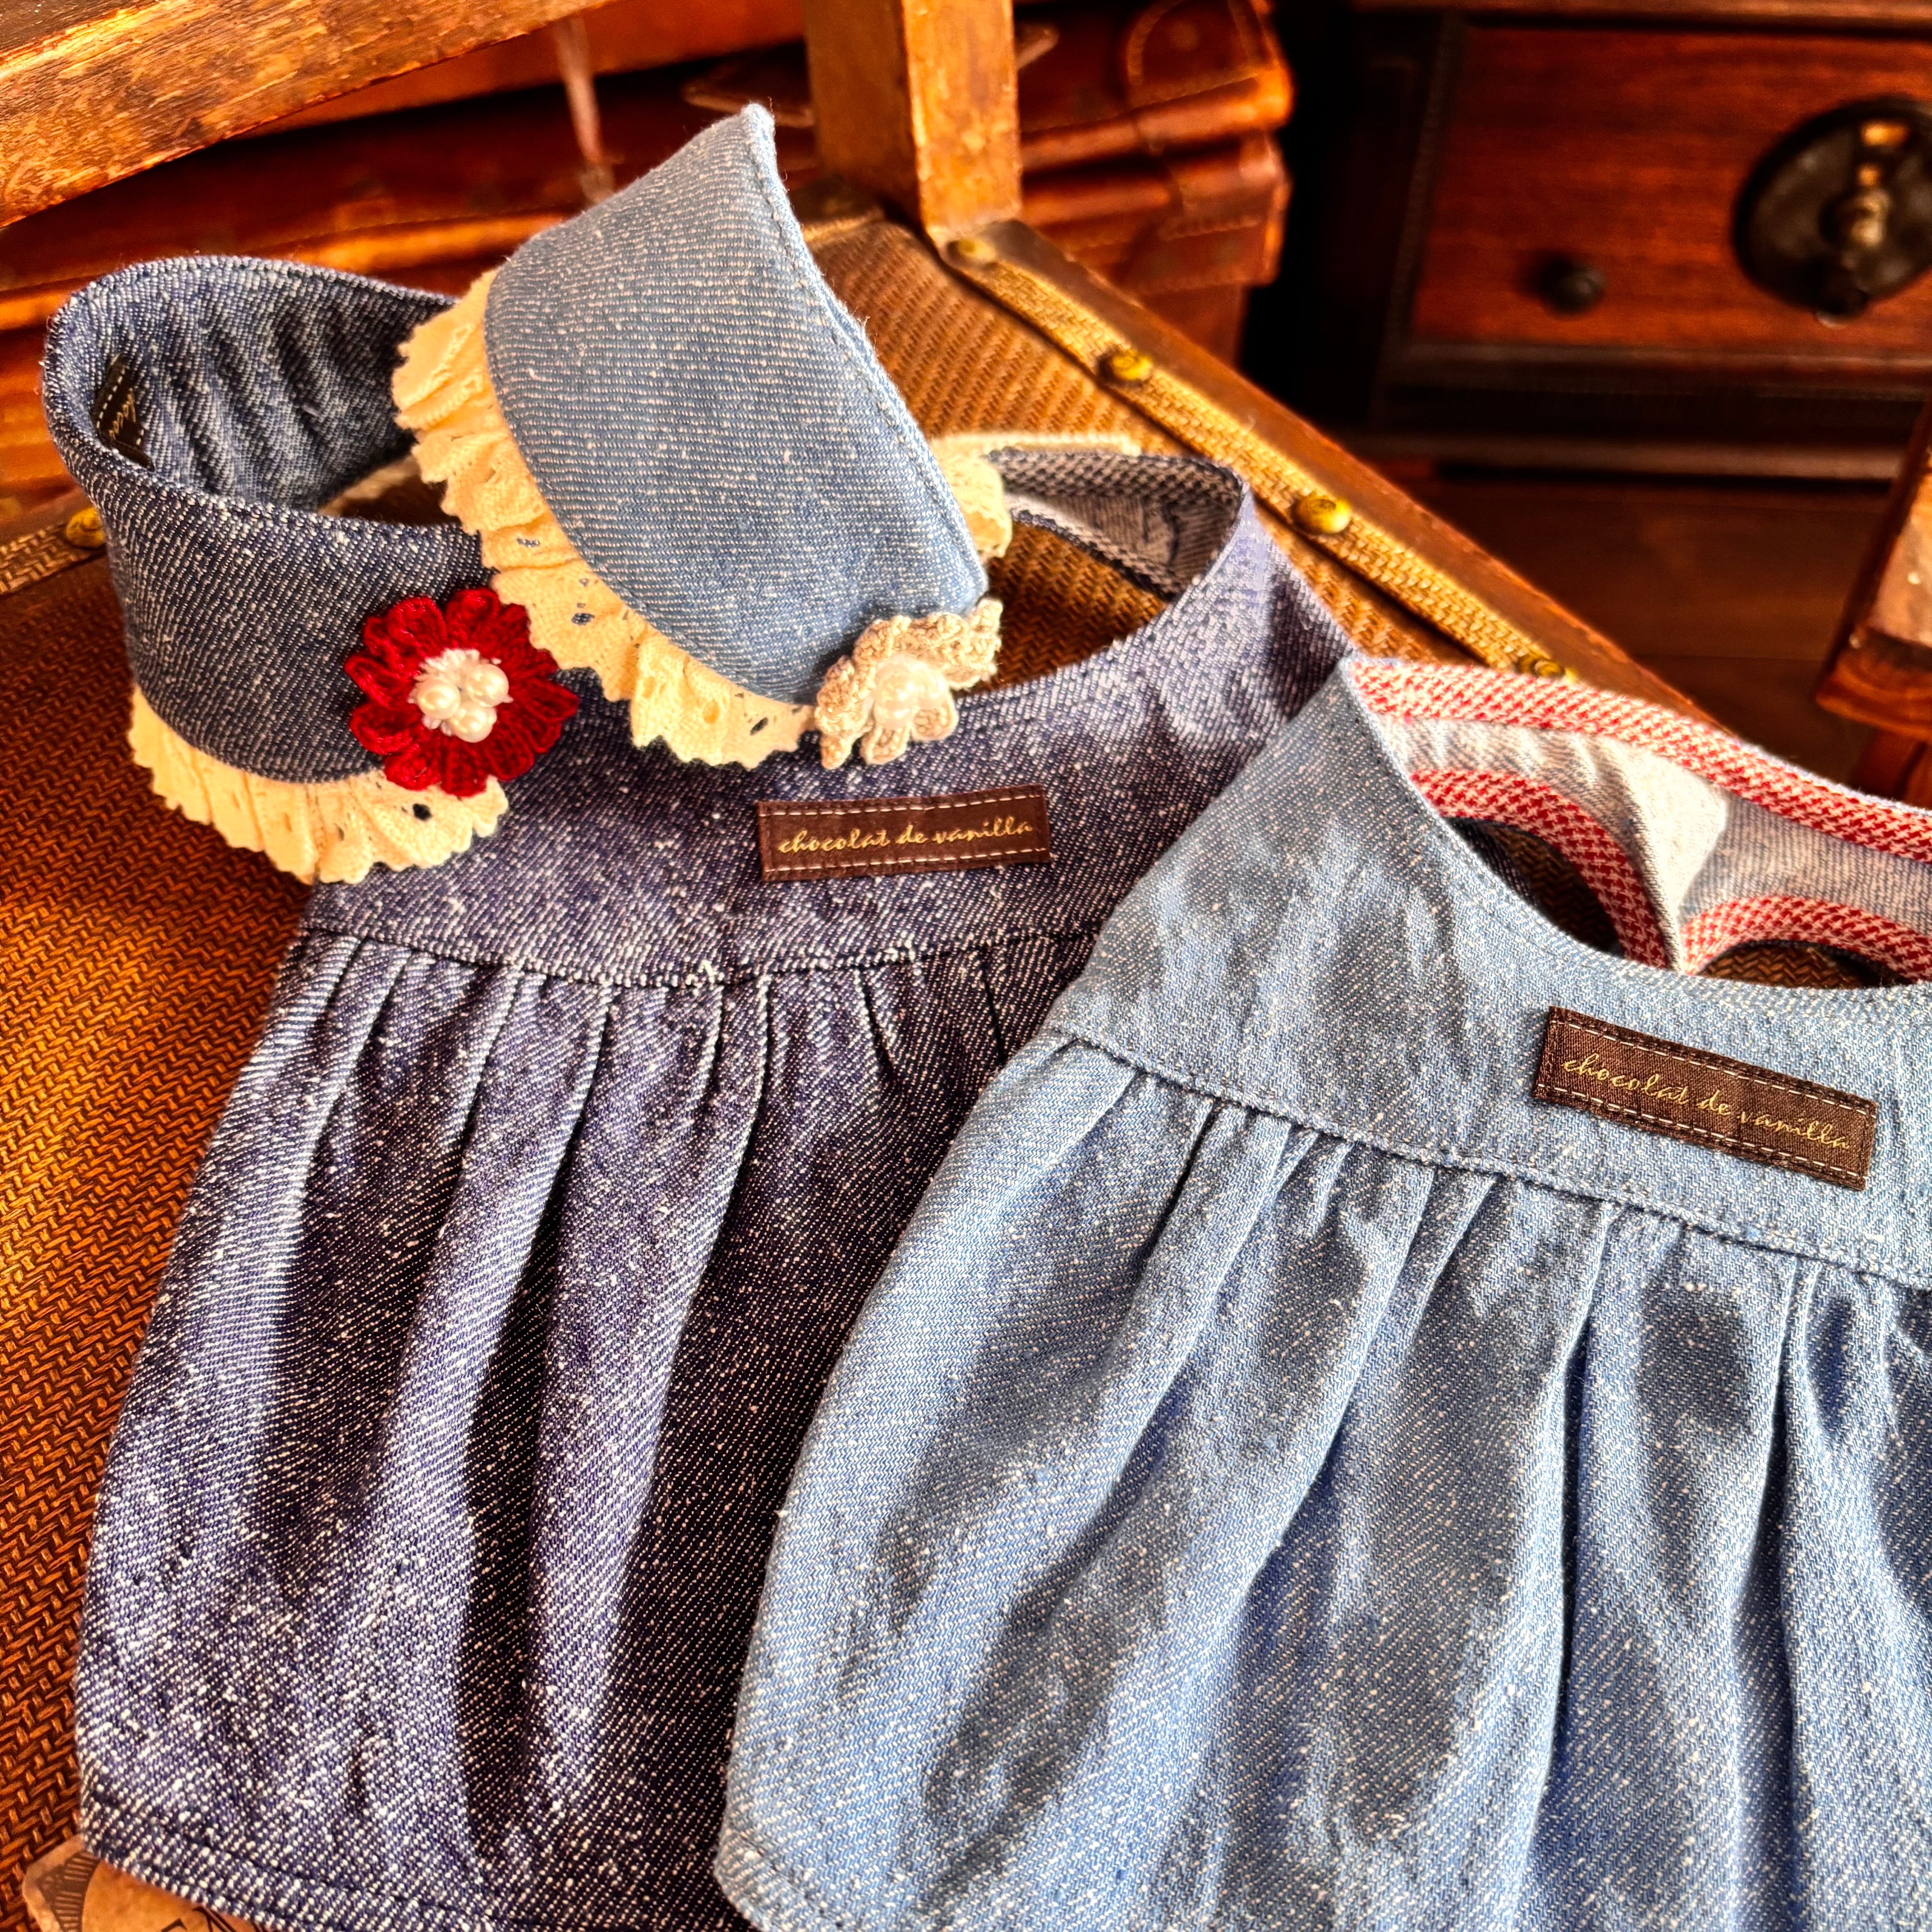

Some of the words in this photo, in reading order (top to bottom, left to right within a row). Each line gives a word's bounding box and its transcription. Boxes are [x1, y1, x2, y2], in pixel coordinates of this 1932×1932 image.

[778, 828, 891, 853] chocolat
[896, 823, 928, 844] de
[932, 816, 1033, 844] vanilla
[1562, 1053, 1689, 1104] chocolat
[1697, 1089, 1731, 1116] de
[1737, 1111, 1849, 1150] vanilla
